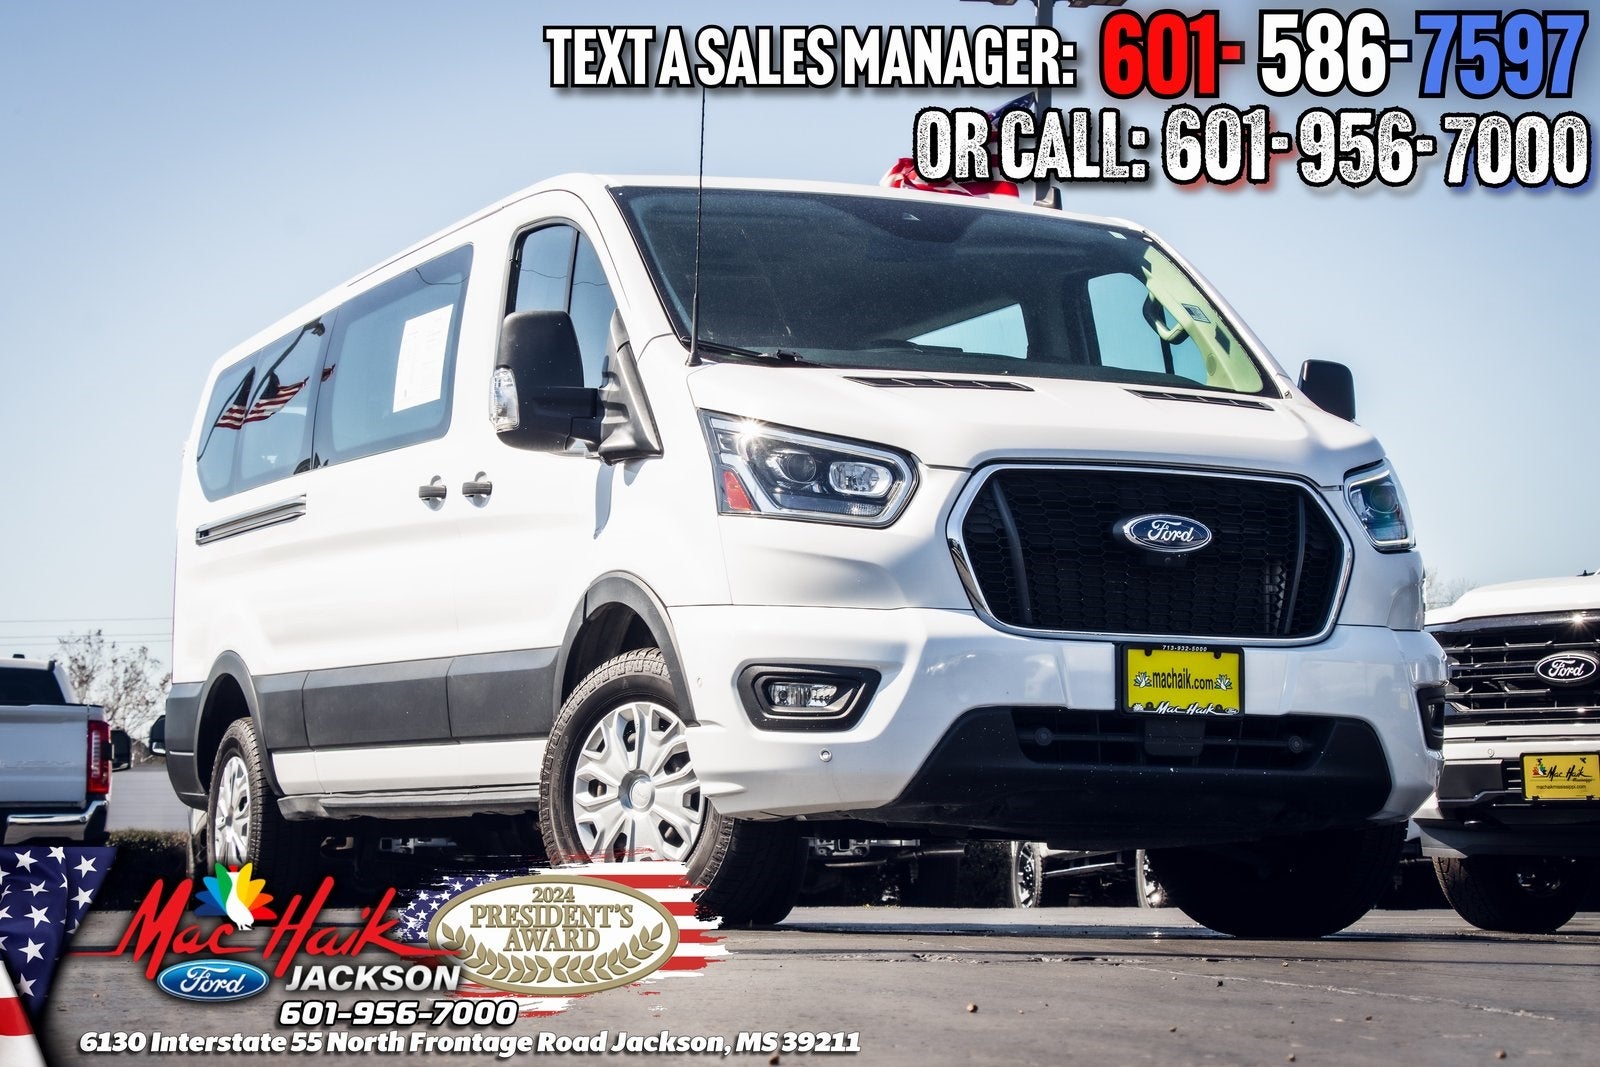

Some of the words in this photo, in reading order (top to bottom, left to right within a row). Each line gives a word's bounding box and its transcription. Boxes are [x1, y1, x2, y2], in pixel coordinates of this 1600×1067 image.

[1148, 520, 1194, 542] Ford
[1548, 659, 1585, 677] Ford
[1152, 668, 1214, 690] machaik.com
[1156, 701, 1180, 715] Mac
[1186, 702, 1217, 716] Haik
[1546, 765, 1563, 781] Mac
[1566, 765, 1592, 781] Haik
